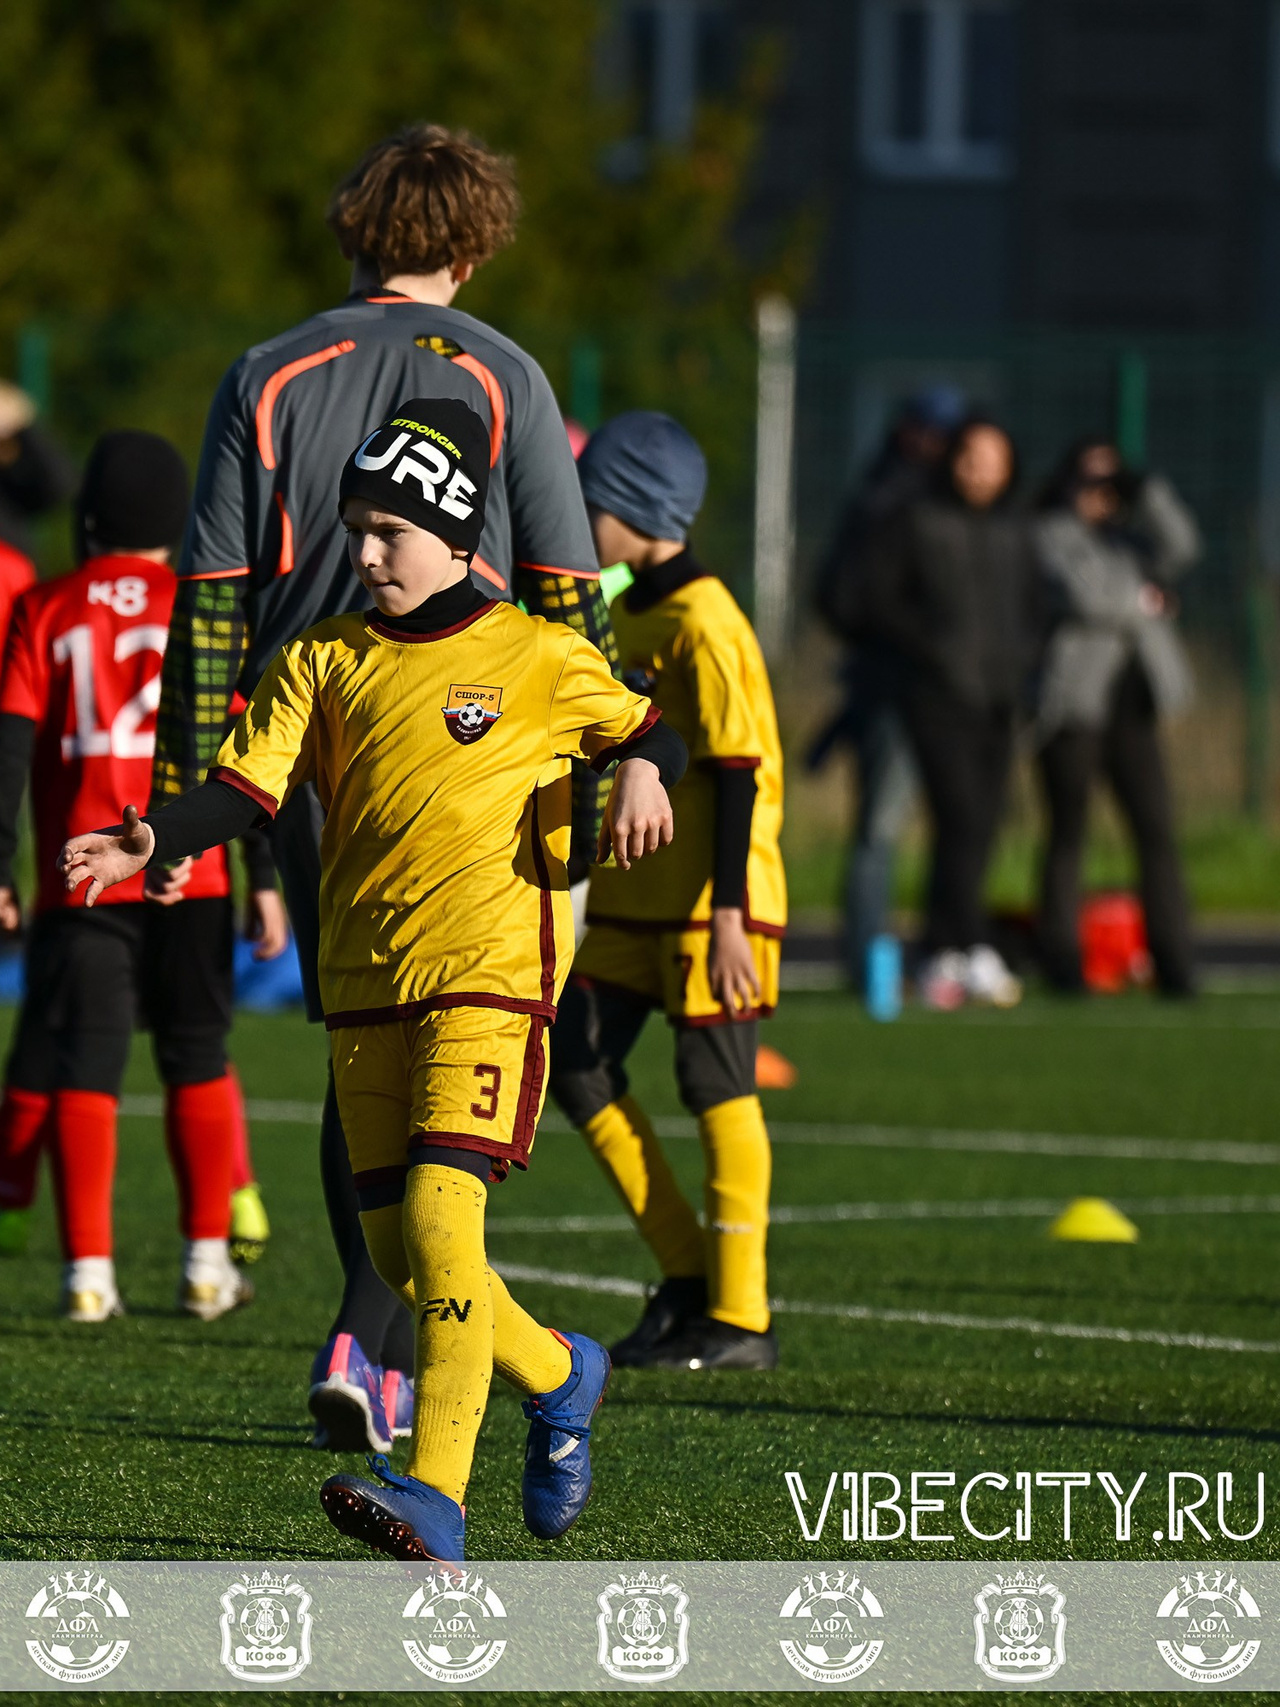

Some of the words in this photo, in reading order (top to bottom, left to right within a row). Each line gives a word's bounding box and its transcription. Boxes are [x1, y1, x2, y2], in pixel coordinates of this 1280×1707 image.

[390, 418, 462, 459] STRONGER
[52, 624, 169, 763] 12
[455, 691, 495, 701] СШОР-5
[470, 1063, 502, 1121] 3
